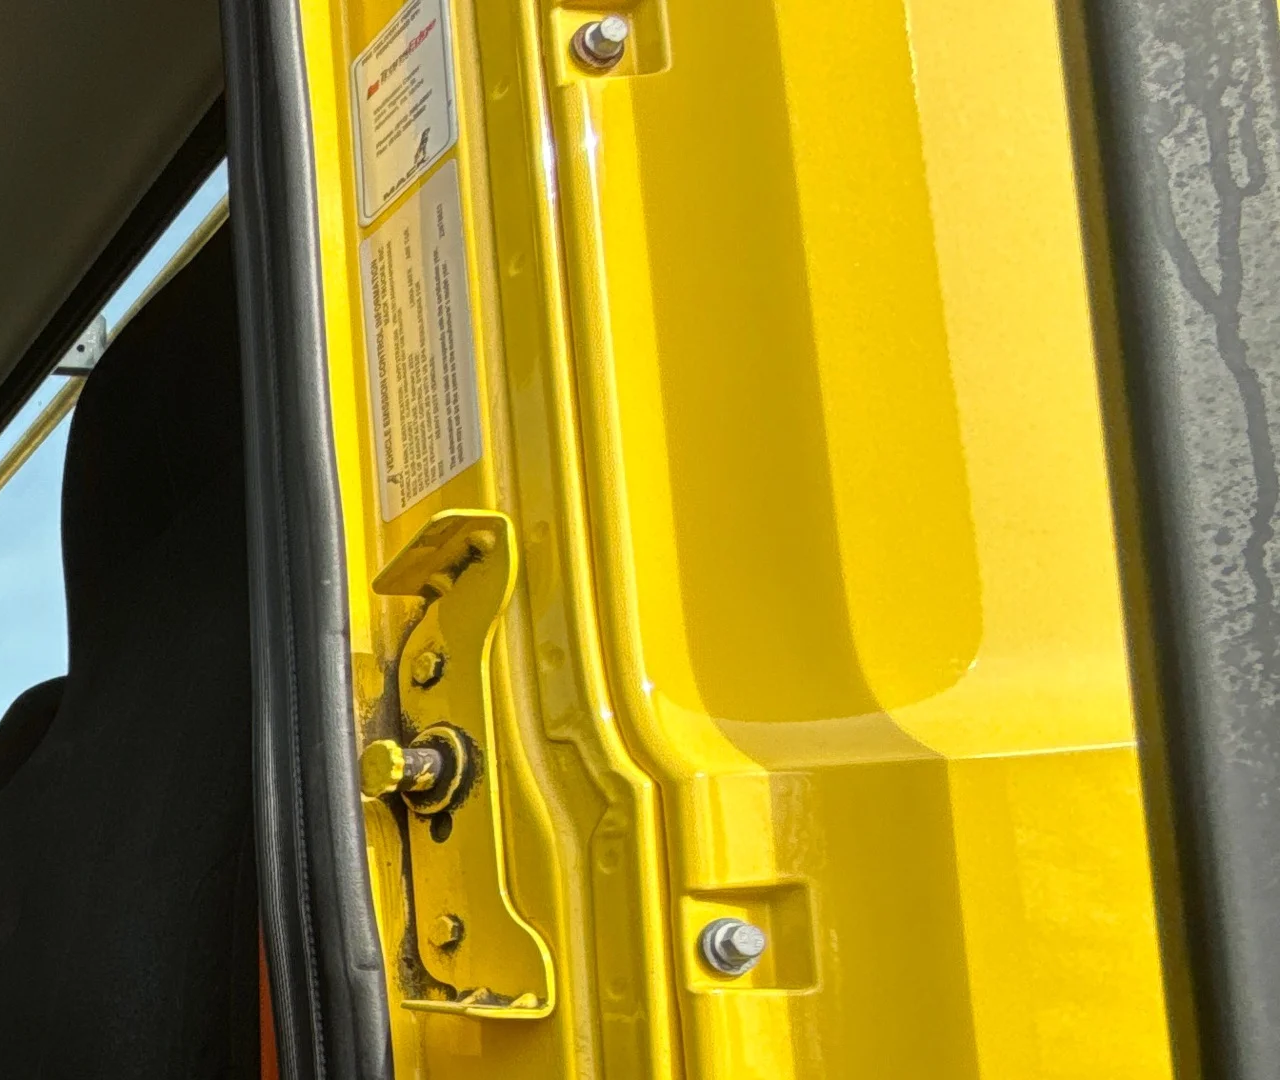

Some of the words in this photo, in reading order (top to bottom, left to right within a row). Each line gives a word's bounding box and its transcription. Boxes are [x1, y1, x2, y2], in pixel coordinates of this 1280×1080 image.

[380, 18, 437, 85] TransEdge
[383, 158, 428, 201] MACK
[368, 257, 383, 329] INFORMATION
[375, 326, 387, 379] CONTROL
[378, 376, 391, 428] EMISSION
[383, 426, 394, 473] VEHICLE
